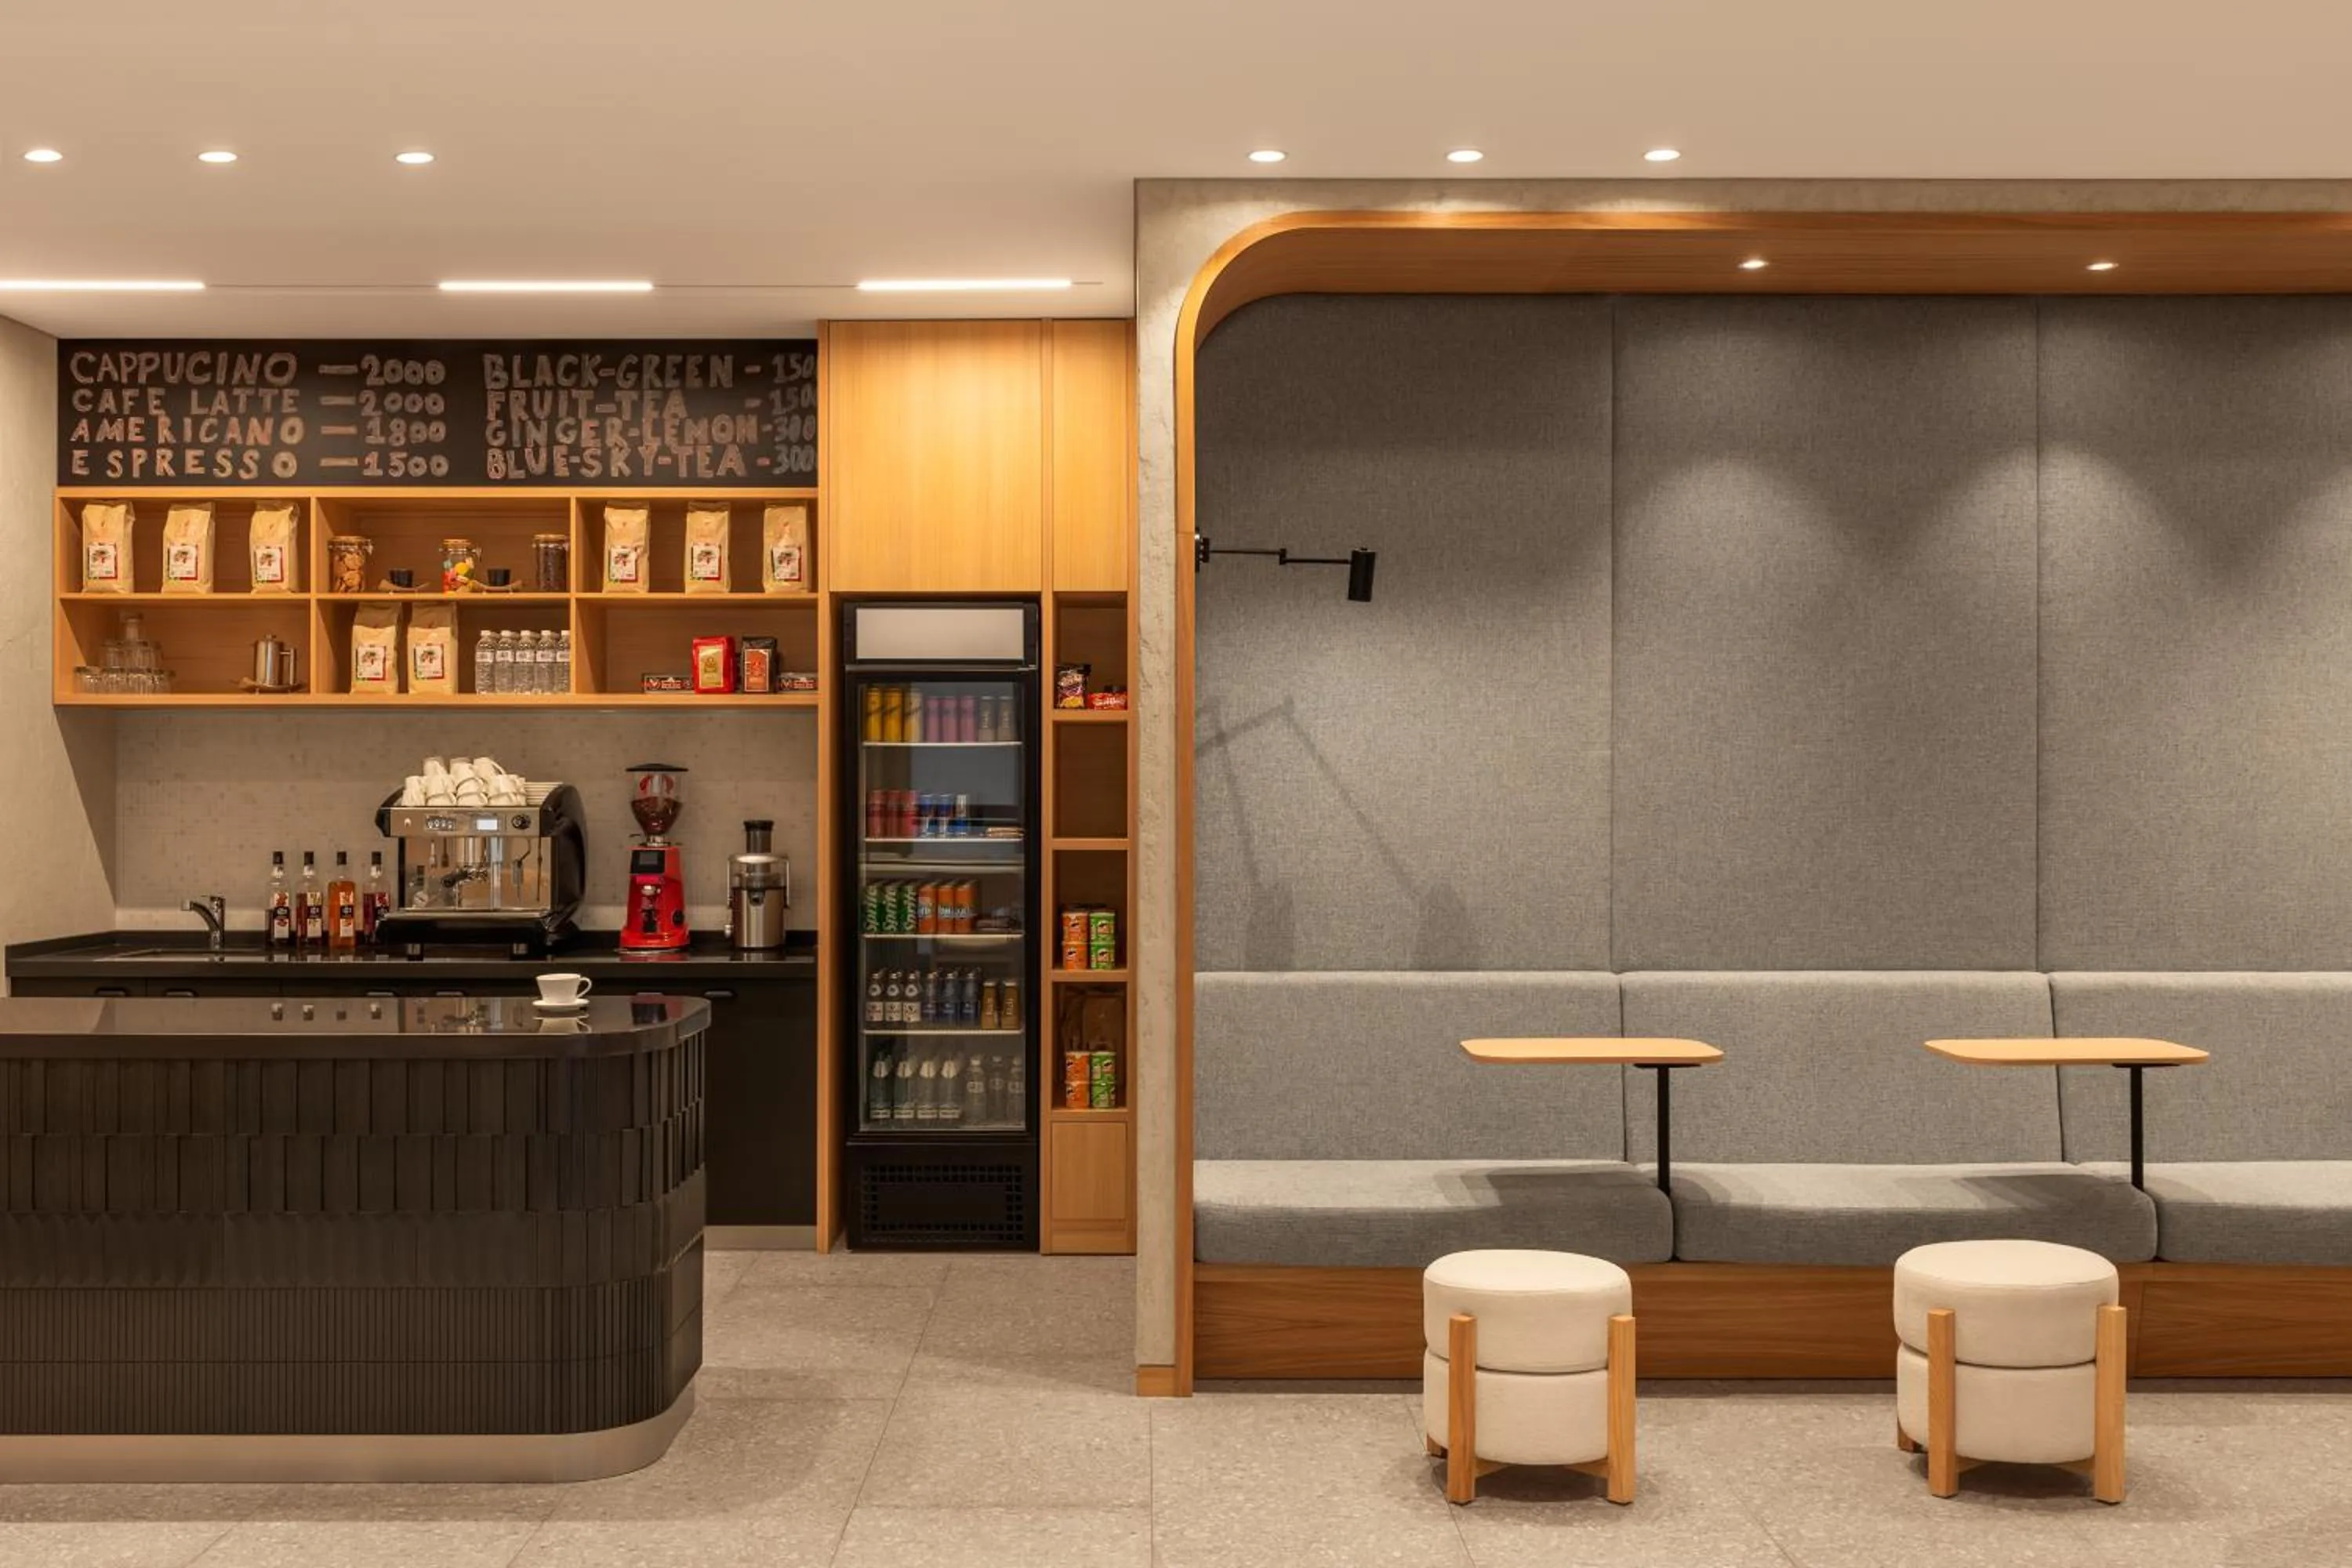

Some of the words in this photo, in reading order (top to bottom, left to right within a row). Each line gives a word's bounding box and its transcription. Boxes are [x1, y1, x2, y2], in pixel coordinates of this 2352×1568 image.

[69, 351, 297, 386] CAPPUCINO
[361, 354, 447, 386] 2000
[483, 354, 734, 390] BLACK-GREEN
[771, 353, 816, 384] 150
[71, 387, 167, 415] CAFE
[190, 387, 300, 416] LATTE
[359, 390, 445, 416] 2000
[486, 389, 688, 421] FRUIT-TEA
[69, 415, 304, 446] AMERICANO
[365, 416, 447, 447] 1800
[485, 414, 758, 448] GINGER-LEMON
[71, 448, 298, 480] ESPRESSO
[362, 451, 450, 477] 1500
[487, 444, 748, 479] BLUE-SKY-TEA
[771, 445, 816, 475] 300
